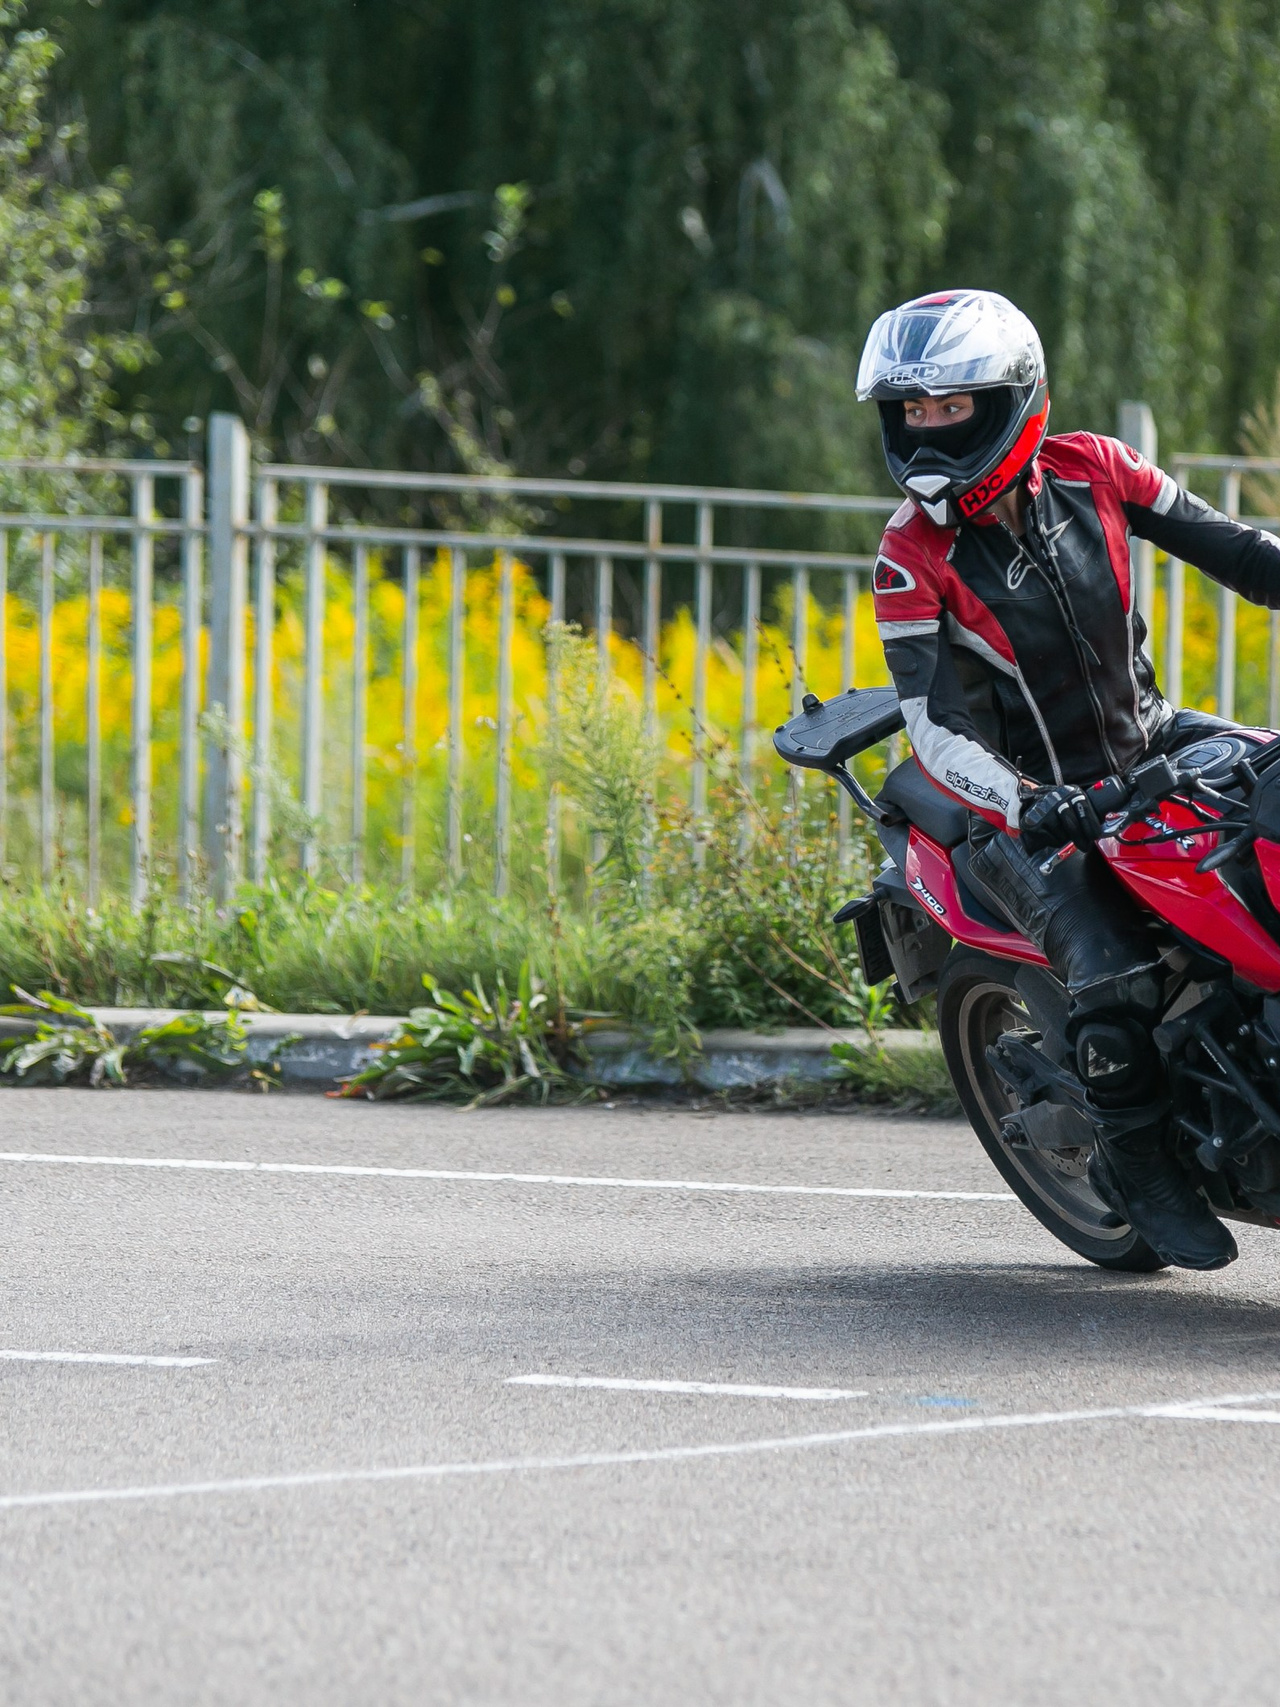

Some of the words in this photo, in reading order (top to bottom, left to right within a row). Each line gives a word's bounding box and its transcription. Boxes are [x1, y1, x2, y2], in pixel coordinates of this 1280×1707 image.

[963, 474, 1003, 511] HJC
[945, 769, 1009, 810] alpinestars
[909, 875, 946, 915] D400
